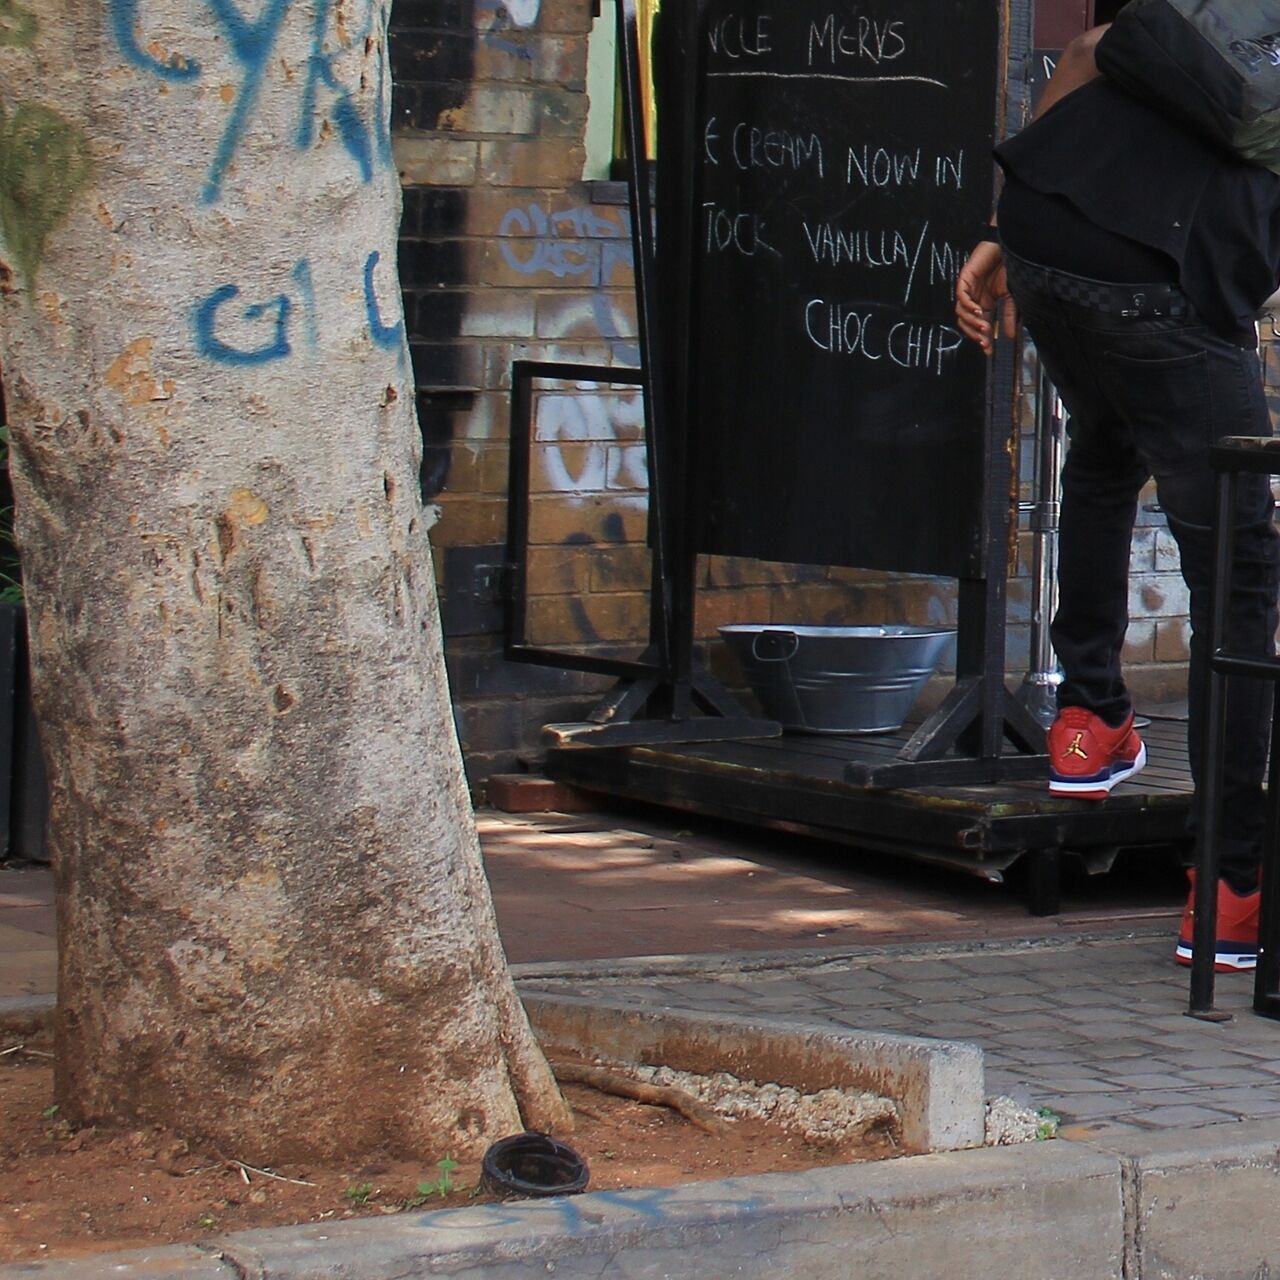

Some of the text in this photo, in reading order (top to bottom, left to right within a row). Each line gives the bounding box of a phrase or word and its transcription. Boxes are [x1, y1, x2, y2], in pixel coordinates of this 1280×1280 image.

[731, 122, 825, 180] CREAM
[846, 144, 921, 188] NOW
[935, 149, 964, 190] IN
[702, 201, 784, 258] TOCK
[805, 298, 963, 376] CHOC CHIP
